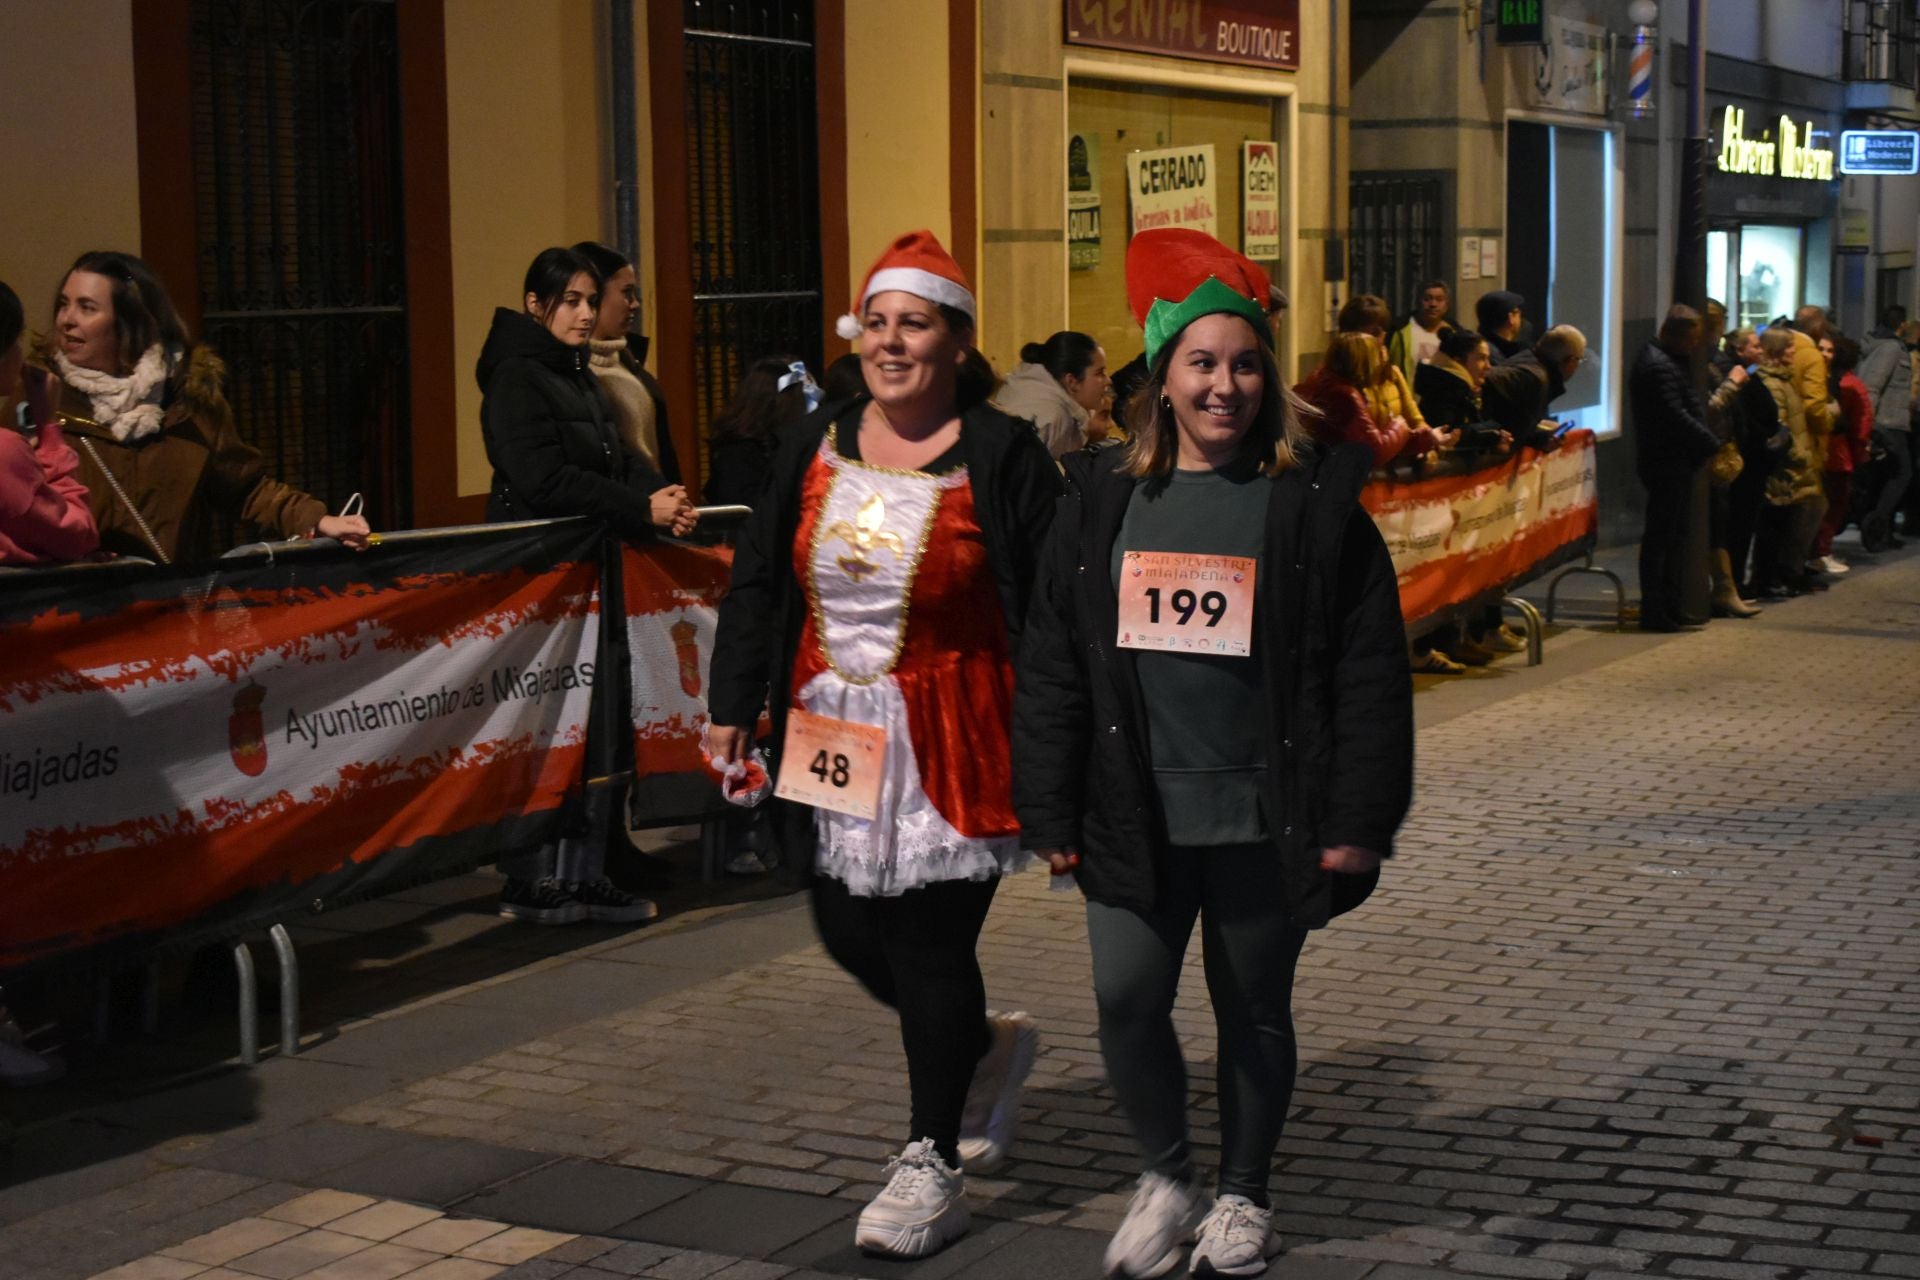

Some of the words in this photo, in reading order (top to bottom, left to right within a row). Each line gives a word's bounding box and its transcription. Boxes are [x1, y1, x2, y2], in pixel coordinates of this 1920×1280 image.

[1503, 0, 1538, 25] BAR
[1217, 21, 1291, 60] BOUTIQUE
[1140, 153, 1206, 195] CERRADO
[1174, 556, 1247, 571] SILVESTRE
[1144, 588, 1227, 628] 199
[286, 685, 461, 749] Ayuntamiento
[461, 679, 484, 708] de
[0, 741, 119, 800] iajadas
[809, 749, 850, 788] 48
